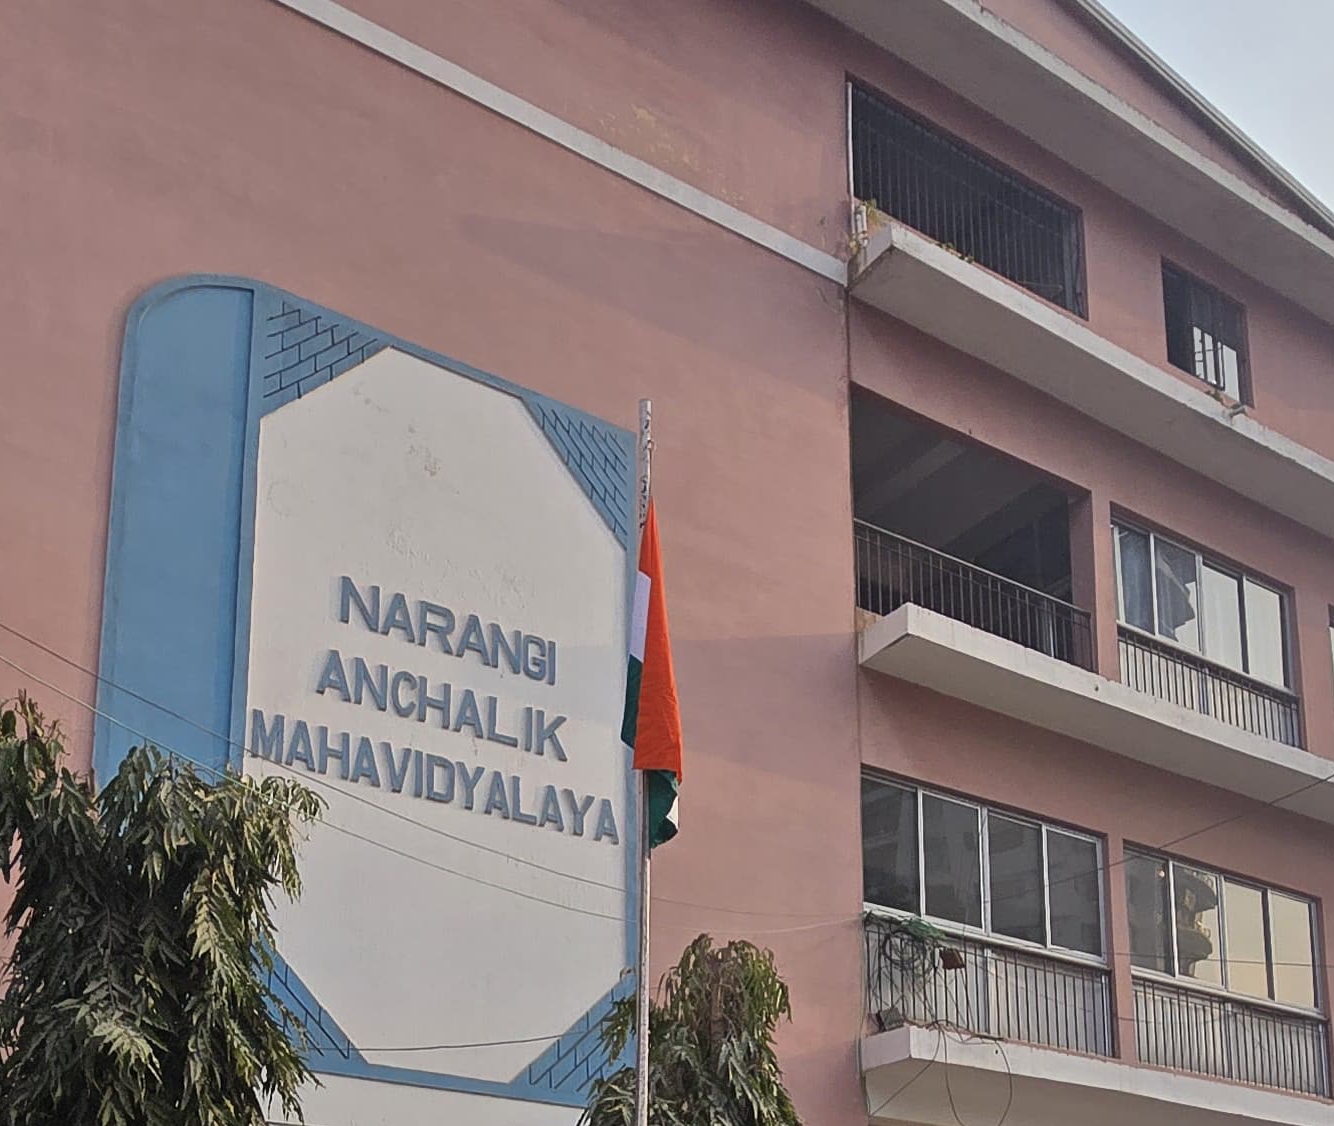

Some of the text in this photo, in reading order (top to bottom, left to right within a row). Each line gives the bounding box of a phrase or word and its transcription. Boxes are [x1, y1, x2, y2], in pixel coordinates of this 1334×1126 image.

[340, 575, 556, 685] NARANGI
[316, 649, 568, 762] ANCHALIK
[250, 708, 620, 846] MAHAVIDYALAYA
